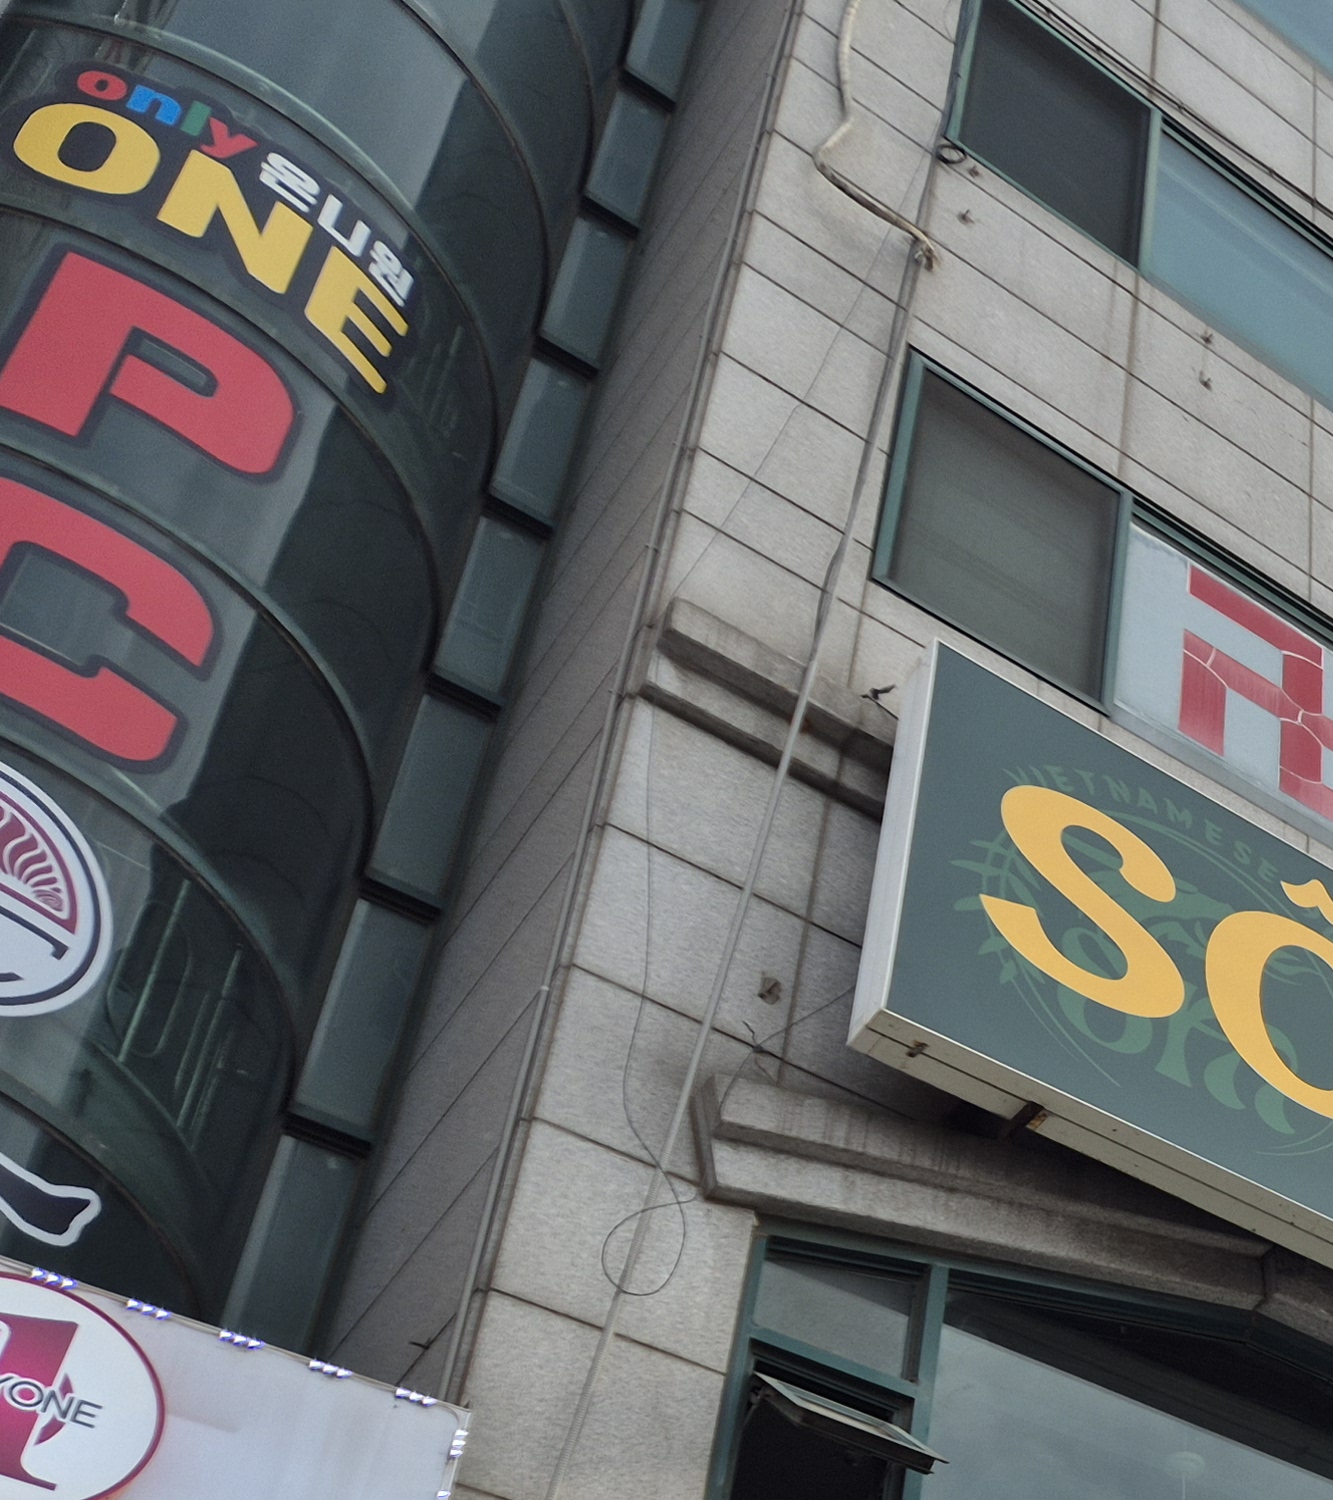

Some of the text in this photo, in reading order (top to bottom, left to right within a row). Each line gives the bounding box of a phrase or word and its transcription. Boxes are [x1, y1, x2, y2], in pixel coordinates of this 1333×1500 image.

[77, 70, 257, 158] only
[14, 103, 408, 394] ONE
[0, 1375, 103, 1429] ONE
